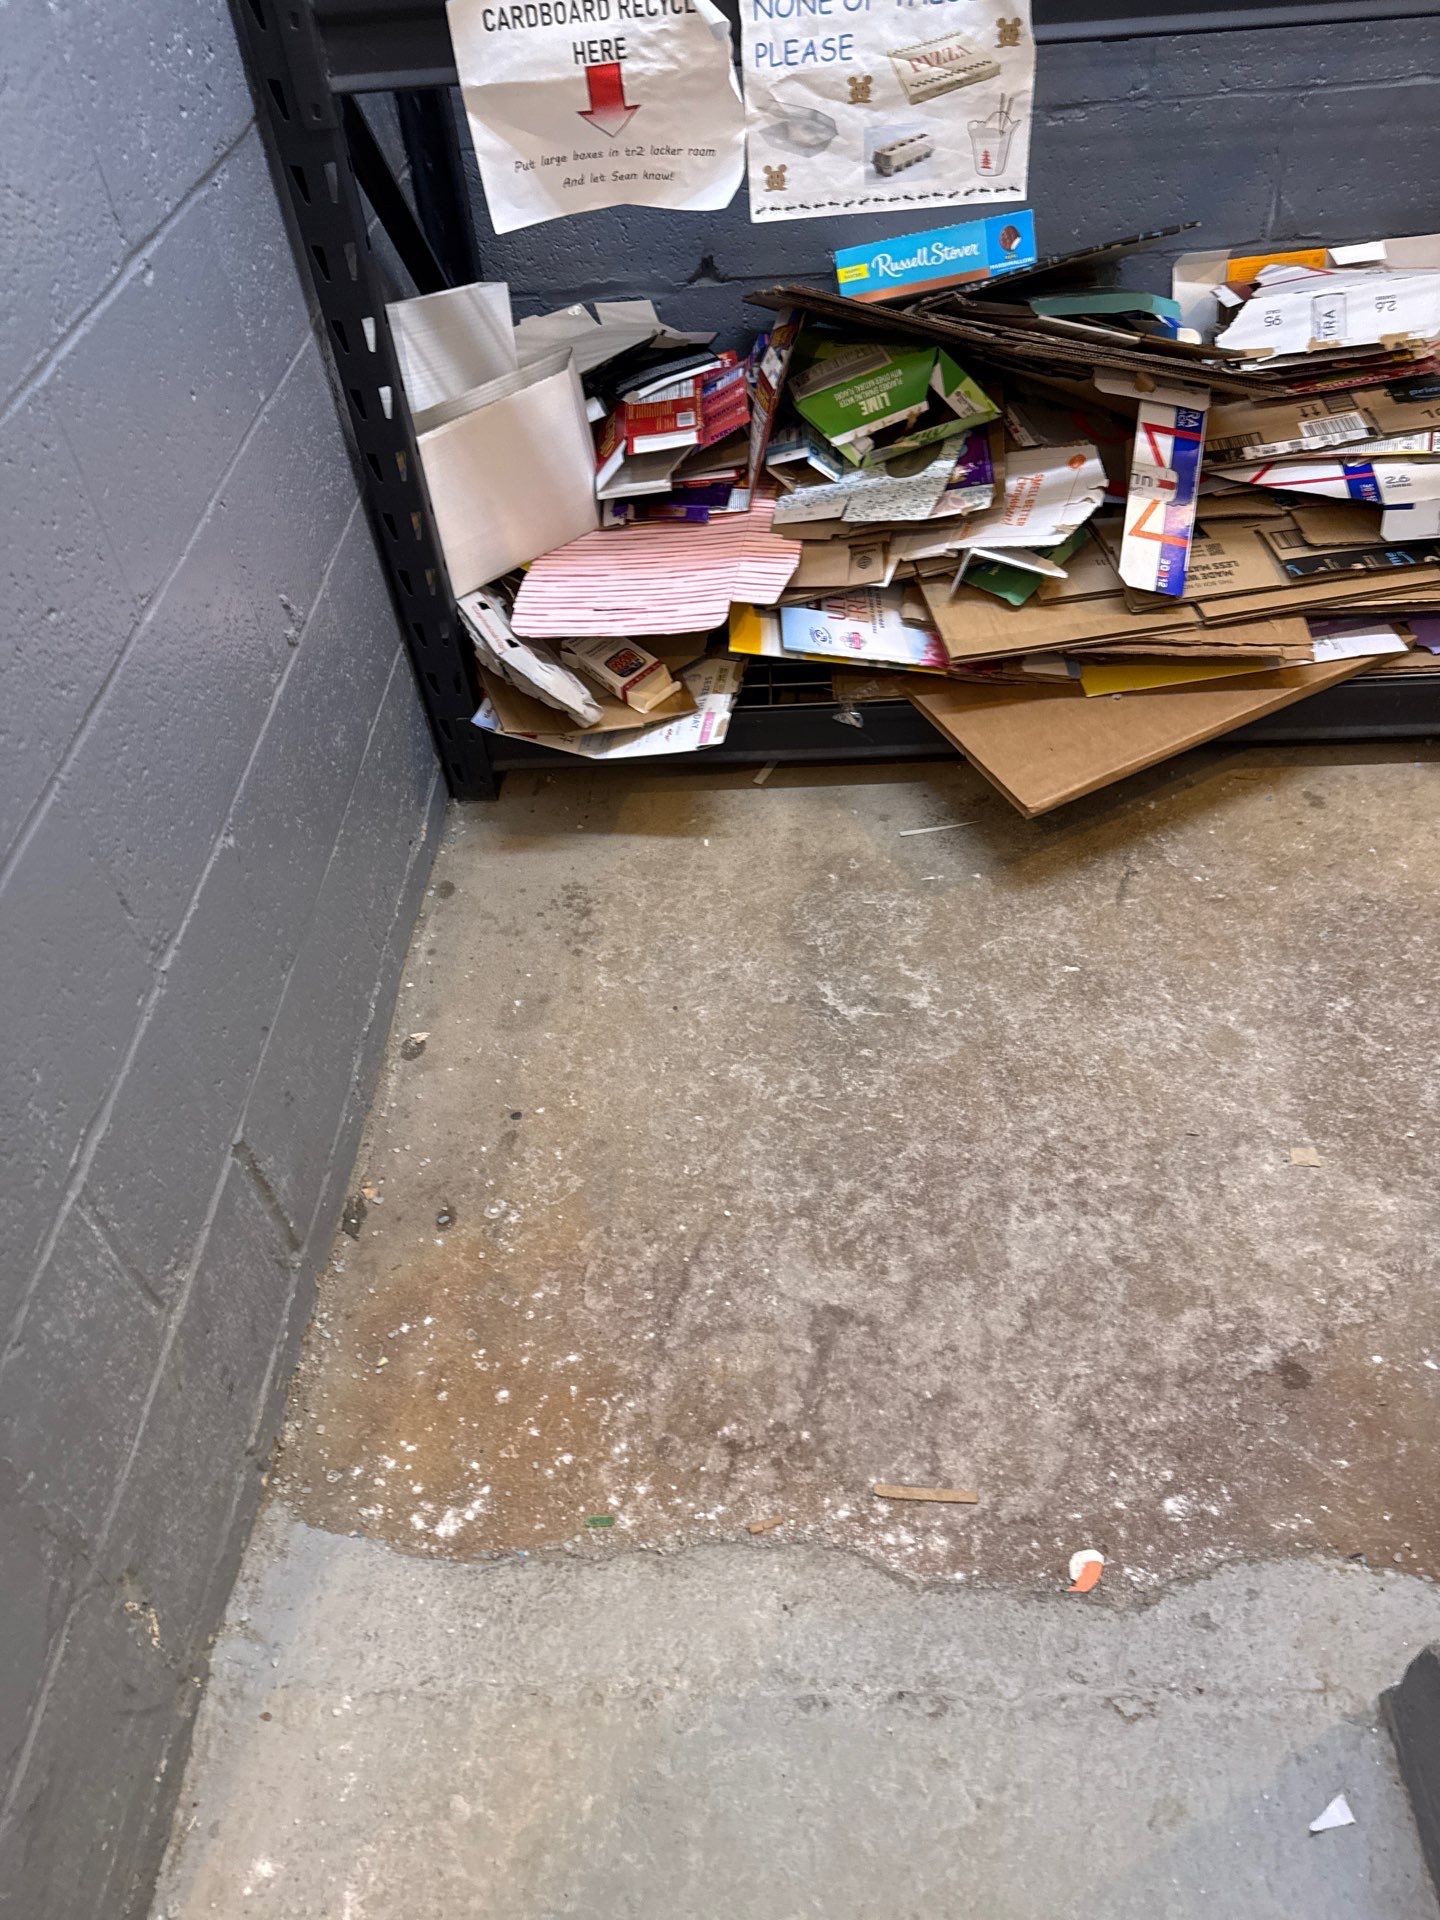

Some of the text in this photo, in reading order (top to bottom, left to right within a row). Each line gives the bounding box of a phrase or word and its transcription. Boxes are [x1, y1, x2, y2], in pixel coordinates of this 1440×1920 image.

[482, 0, 696, 31] CARDBOARD RECYCL
[573, 37, 627, 64] HERE
[755, 34, 854, 68] PLEASE
[514, 159, 536, 173] Put
[541, 150, 567, 167] large
[573, 149, 604, 161] boxes
[609, 147, 624, 158] in
[650, 144, 684, 156] locker
[688, 147, 717, 157] room
[562, 174, 585, 188] And
[590, 172, 606, 183] let
[871, 247, 931, 277] Russell
[930, 242, 981, 266] Stover
[858, 392, 891, 416] LIME
